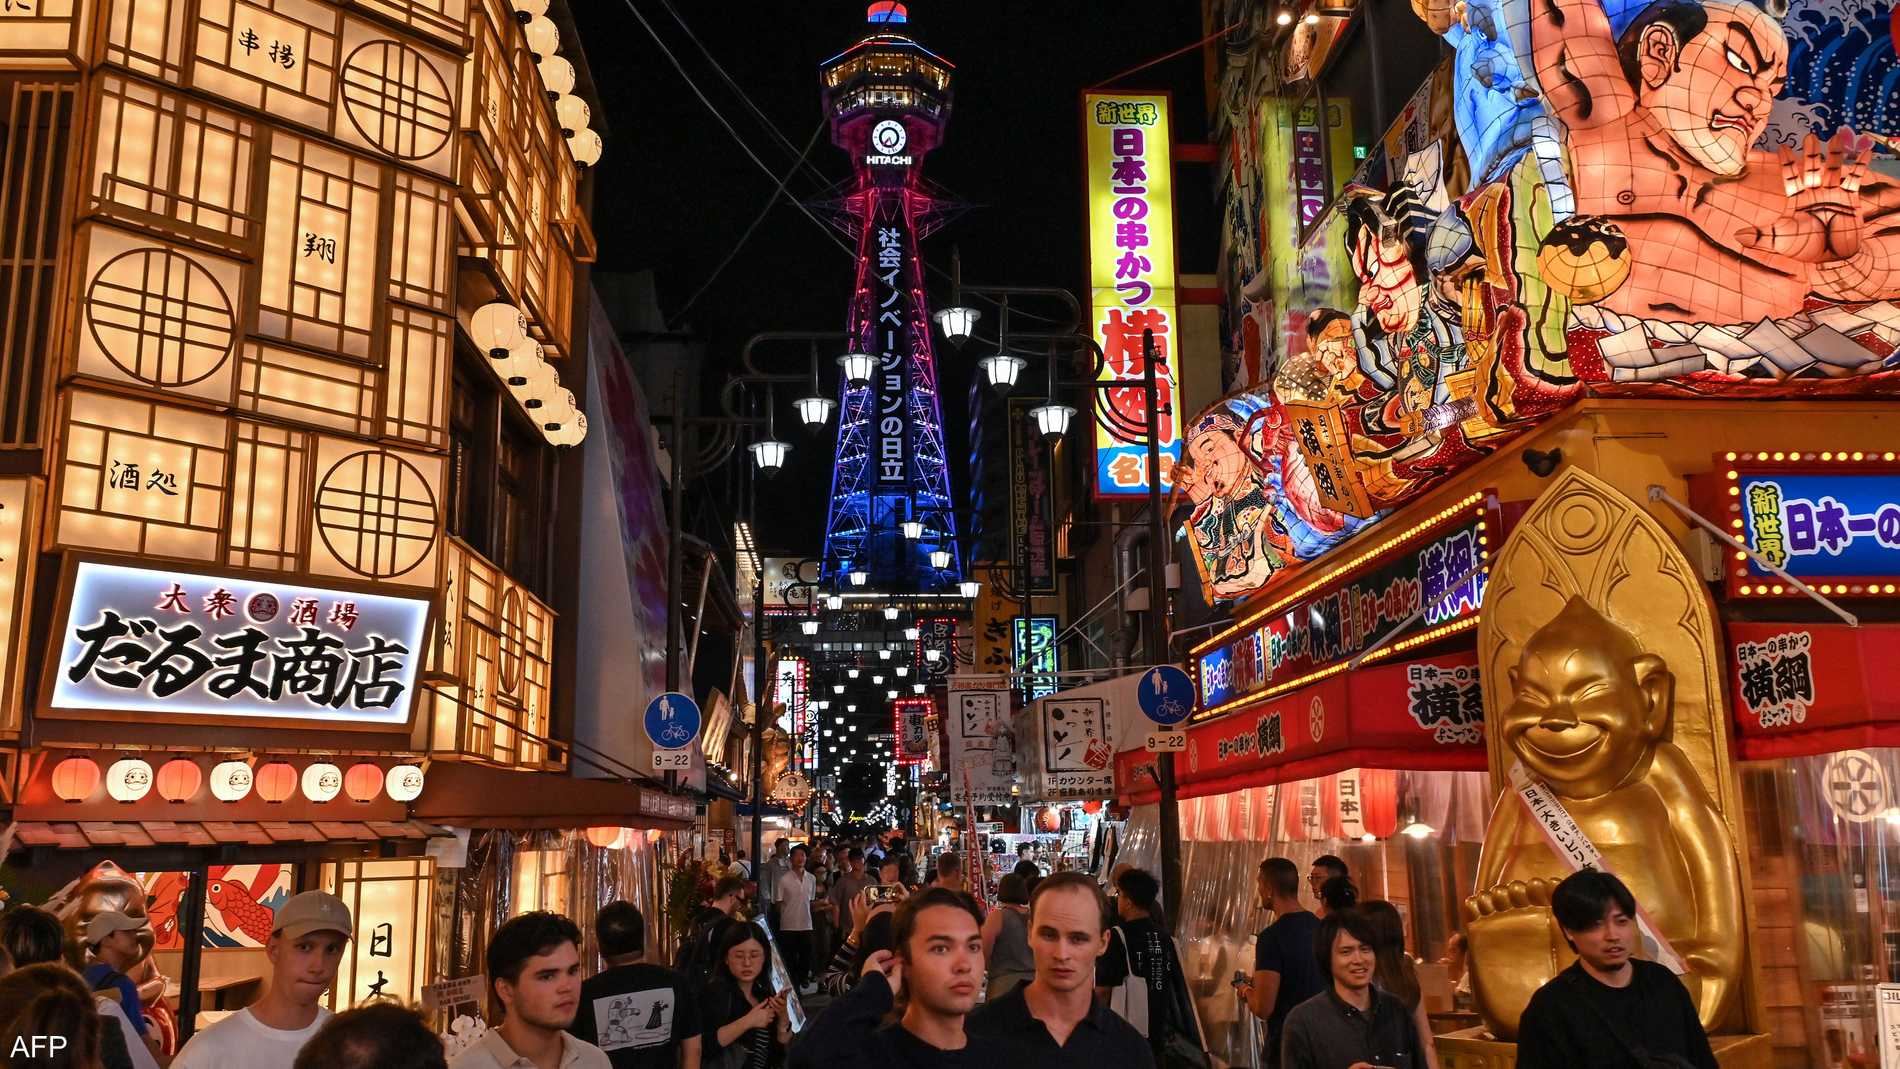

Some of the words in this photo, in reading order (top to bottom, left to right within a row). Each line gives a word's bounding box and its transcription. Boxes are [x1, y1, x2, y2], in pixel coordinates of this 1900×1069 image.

[238, 27, 297, 71] 串揚
[1097, 102, 1157, 125] 新世界
[866, 155, 912, 165] HITACHI
[1111, 128, 1152, 305] 日本一の串かつ
[303, 232, 336, 265] 翔
[878, 227, 904, 481] 社会イノベーションの日立
[109, 460, 178, 496] 酒処
[1750, 485, 1786, 567] 新世界
[1786, 500, 1900, 551] 日本一の
[156, 583, 238, 620] 大衆
[288, 598, 359, 631] 酒場
[68, 611, 408, 711] だるま商店
[1739, 635, 1809, 660] 日本一の串かつ
[1741, 652, 1812, 709] 横綱
